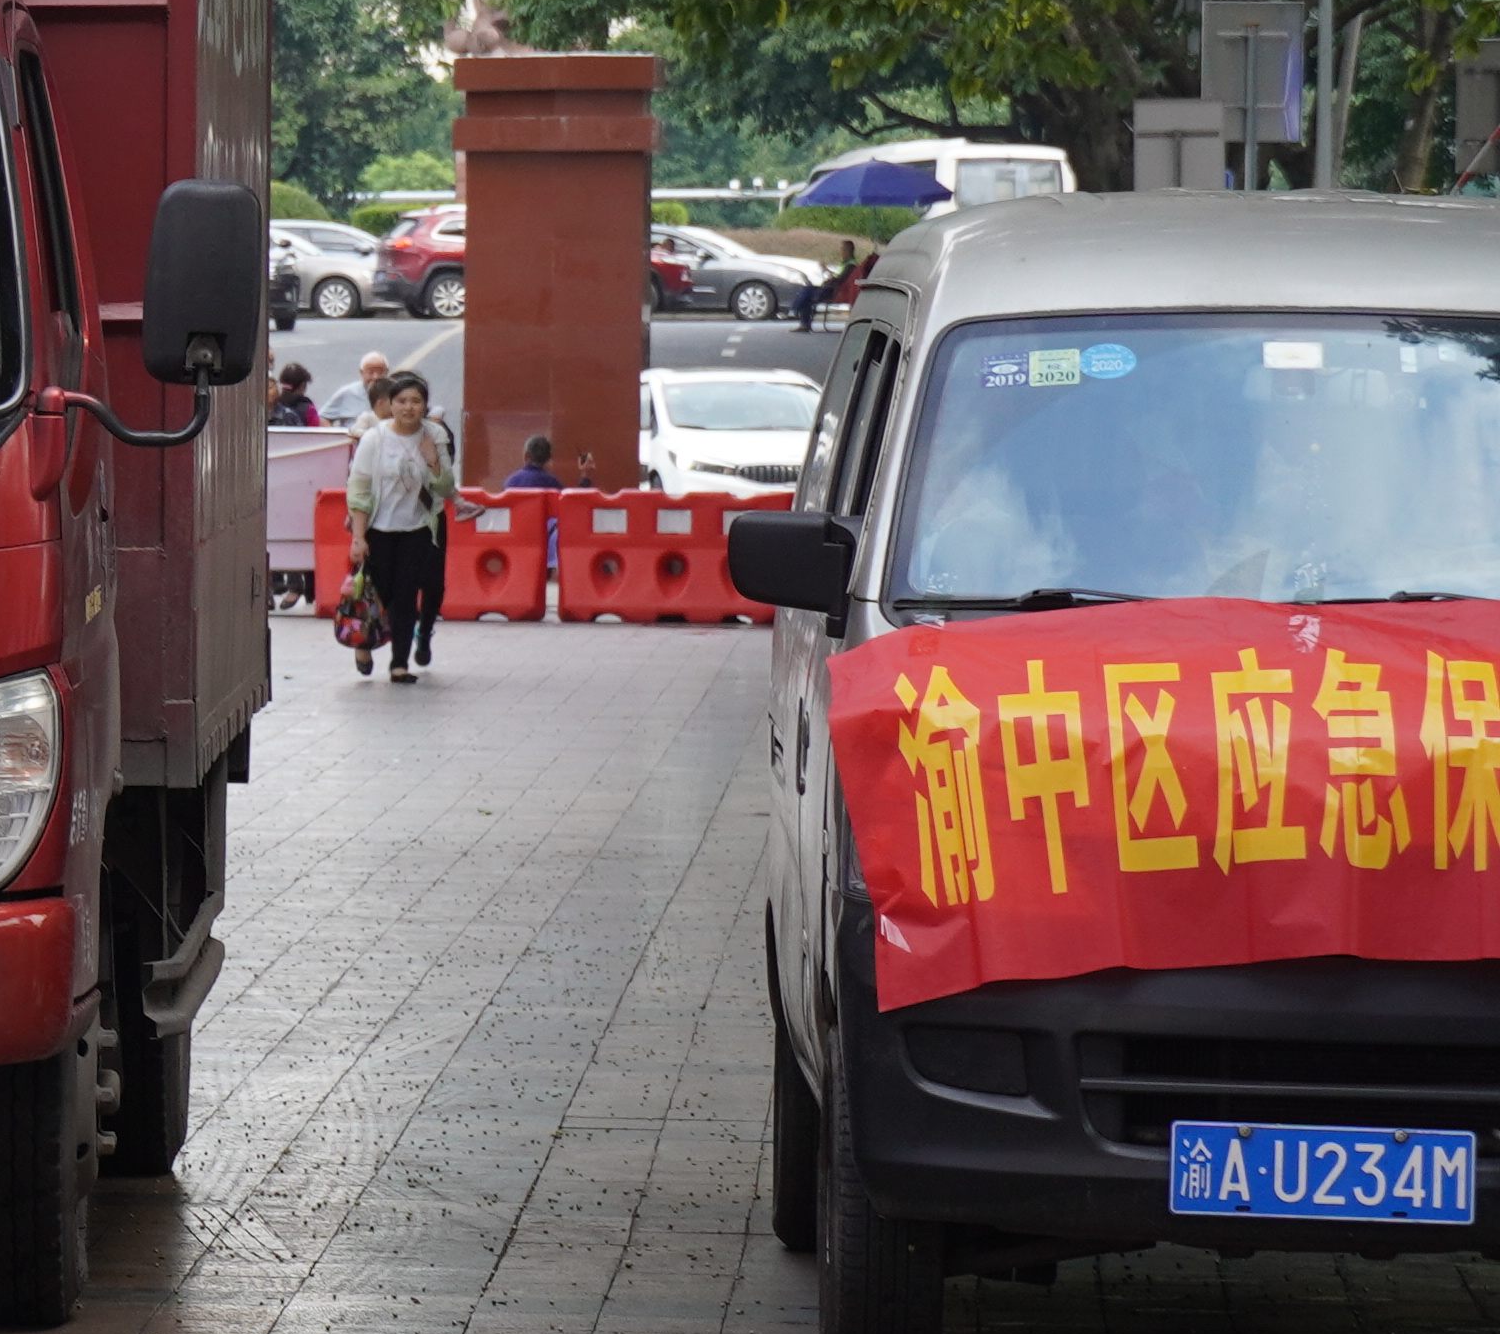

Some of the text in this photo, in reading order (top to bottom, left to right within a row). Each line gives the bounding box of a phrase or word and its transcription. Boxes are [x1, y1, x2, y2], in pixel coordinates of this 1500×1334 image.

[1092, 360, 1124, 372] 2020
[985, 373, 1027, 387] 2019
[1036, 371, 1076, 383] 2020
[894, 648, 1500, 907] 渝中区应急保
